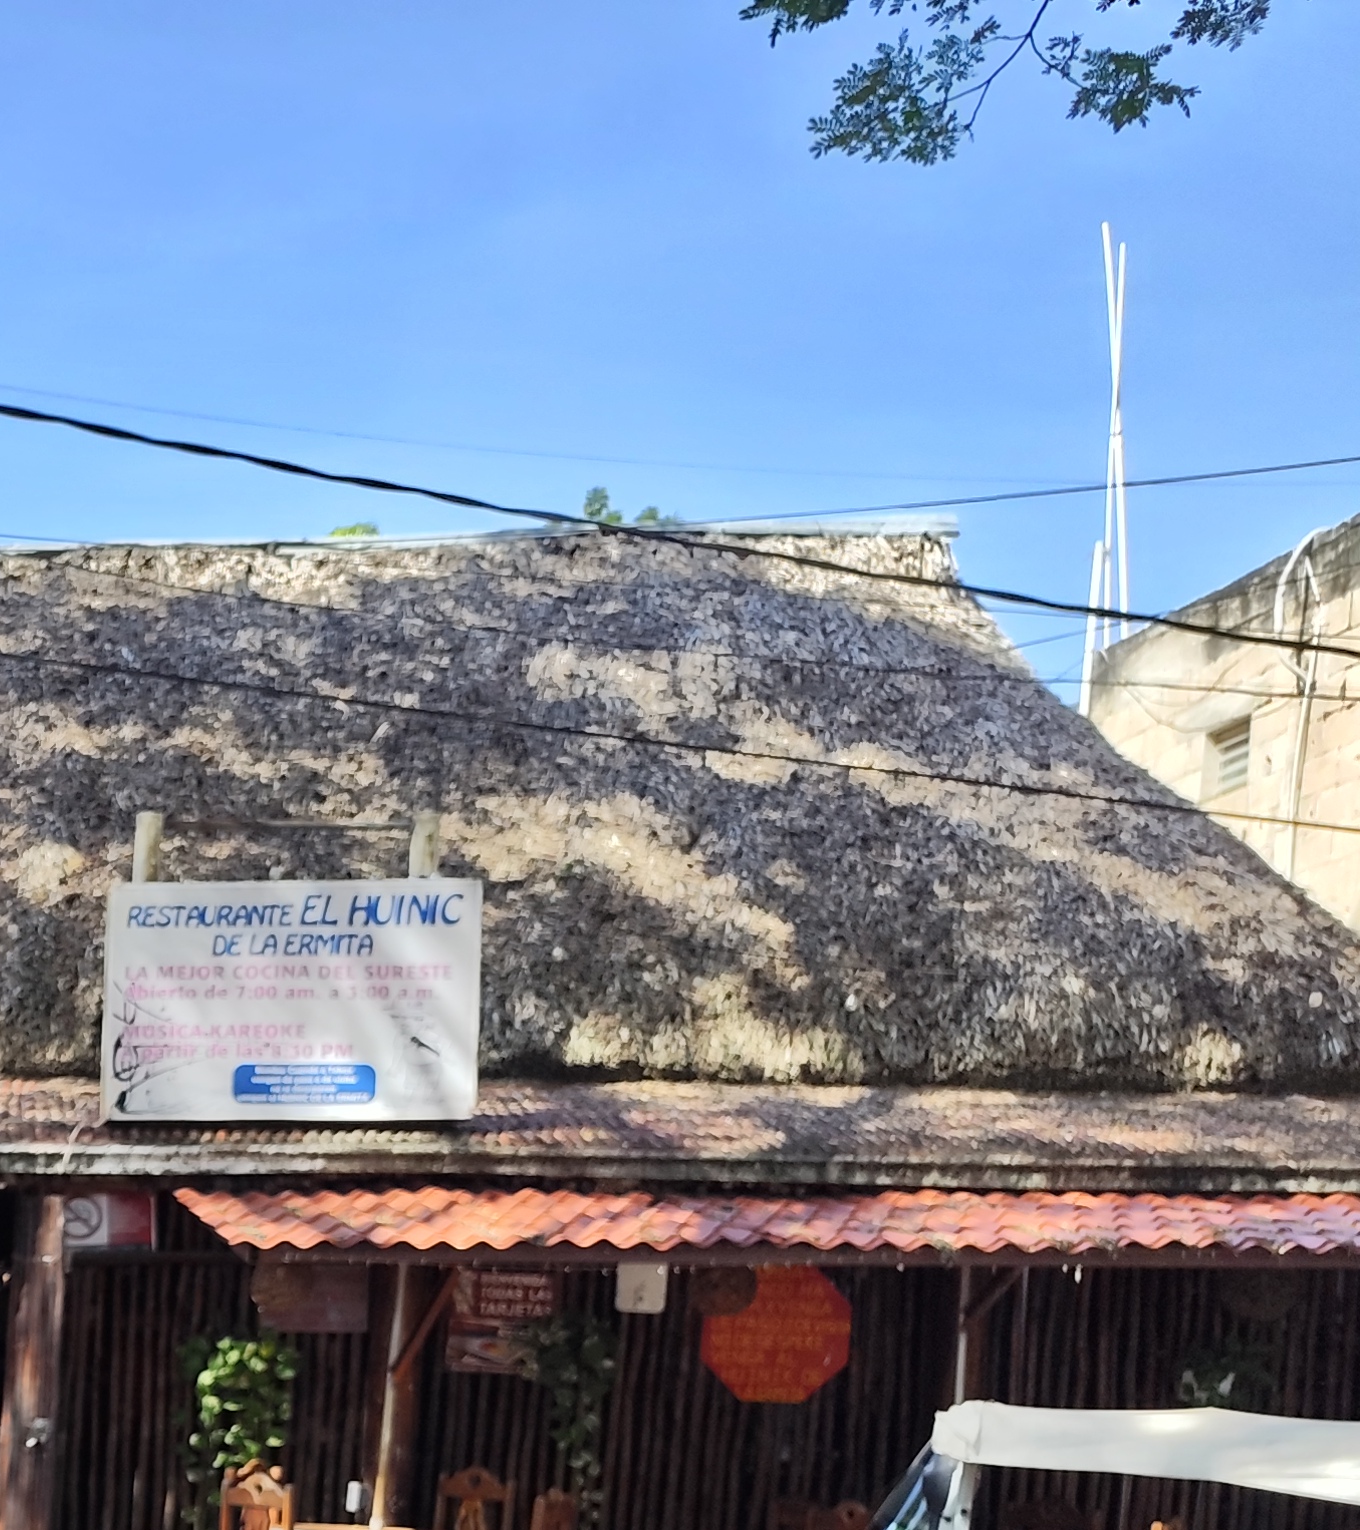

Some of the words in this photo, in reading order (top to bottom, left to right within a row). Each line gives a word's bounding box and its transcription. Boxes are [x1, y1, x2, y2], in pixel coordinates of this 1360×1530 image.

[127, 904, 294, 928] RESTAURANTE
[300, 893, 338, 926] EL
[348, 893, 464, 927] HUINIC
[212, 934, 243, 957] DE
[248, 933, 278, 957] LA
[283, 933, 374, 957] ERMITA
[124, 966, 148, 981] LA
[157, 965, 225, 981] MEJOR
[233, 965, 310, 981] COCINA
[318, 965, 356, 980] DEL
[364, 965, 453, 980] SURESTE
[204, 985, 228, 999] de
[237, 986, 277, 999] 7:00
[331, 988, 339, 999] a
[205, 1043, 228, 1058] de
[321, 1044, 354, 1059] PM
